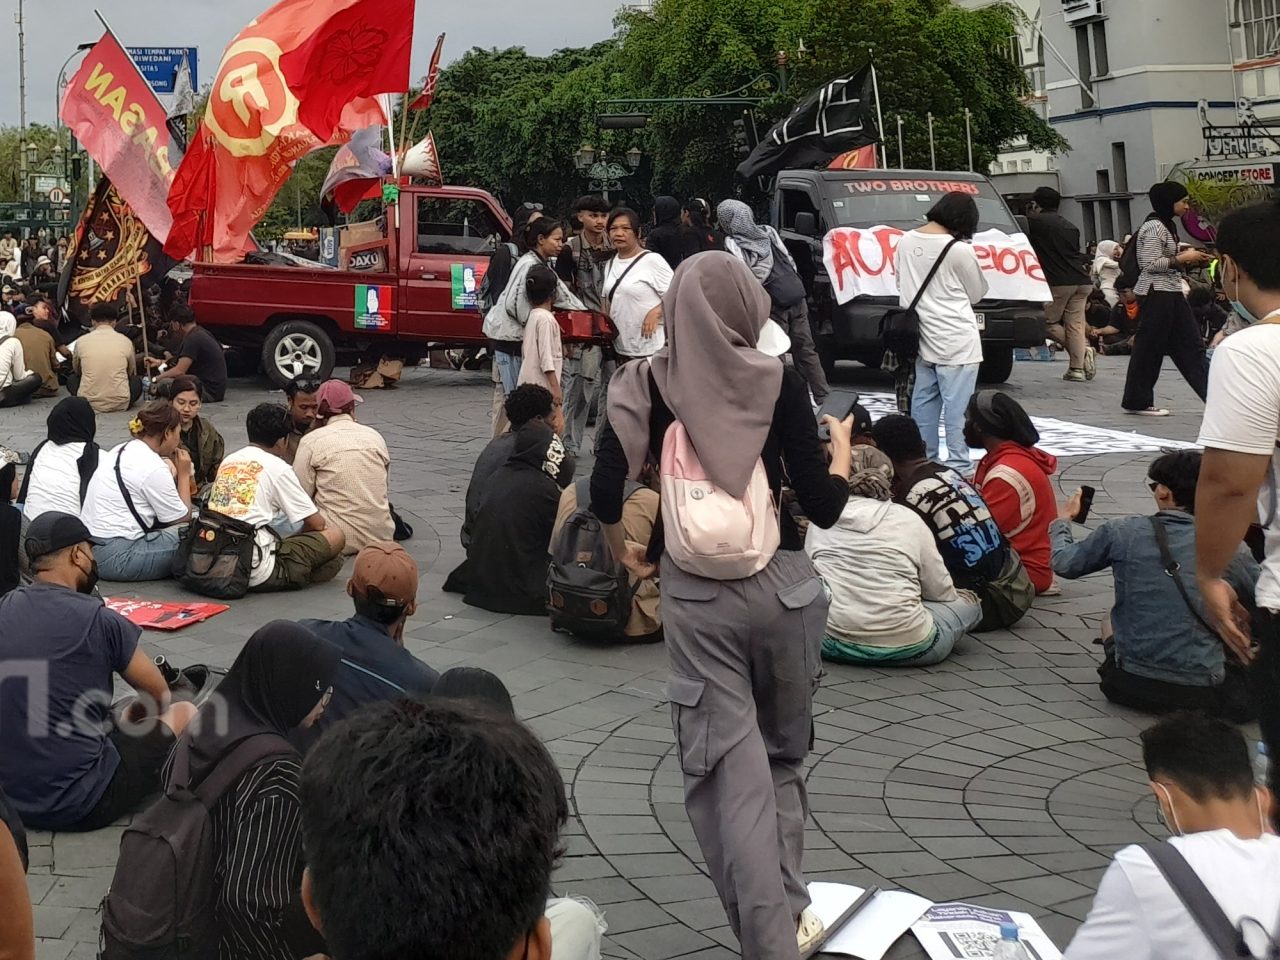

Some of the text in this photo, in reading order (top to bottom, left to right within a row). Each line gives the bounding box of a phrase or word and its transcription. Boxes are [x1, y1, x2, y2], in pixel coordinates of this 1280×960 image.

[1198, 168, 1272, 182] CONCEPT STORE
[844, 180, 980, 195] TWO BROTHERS
